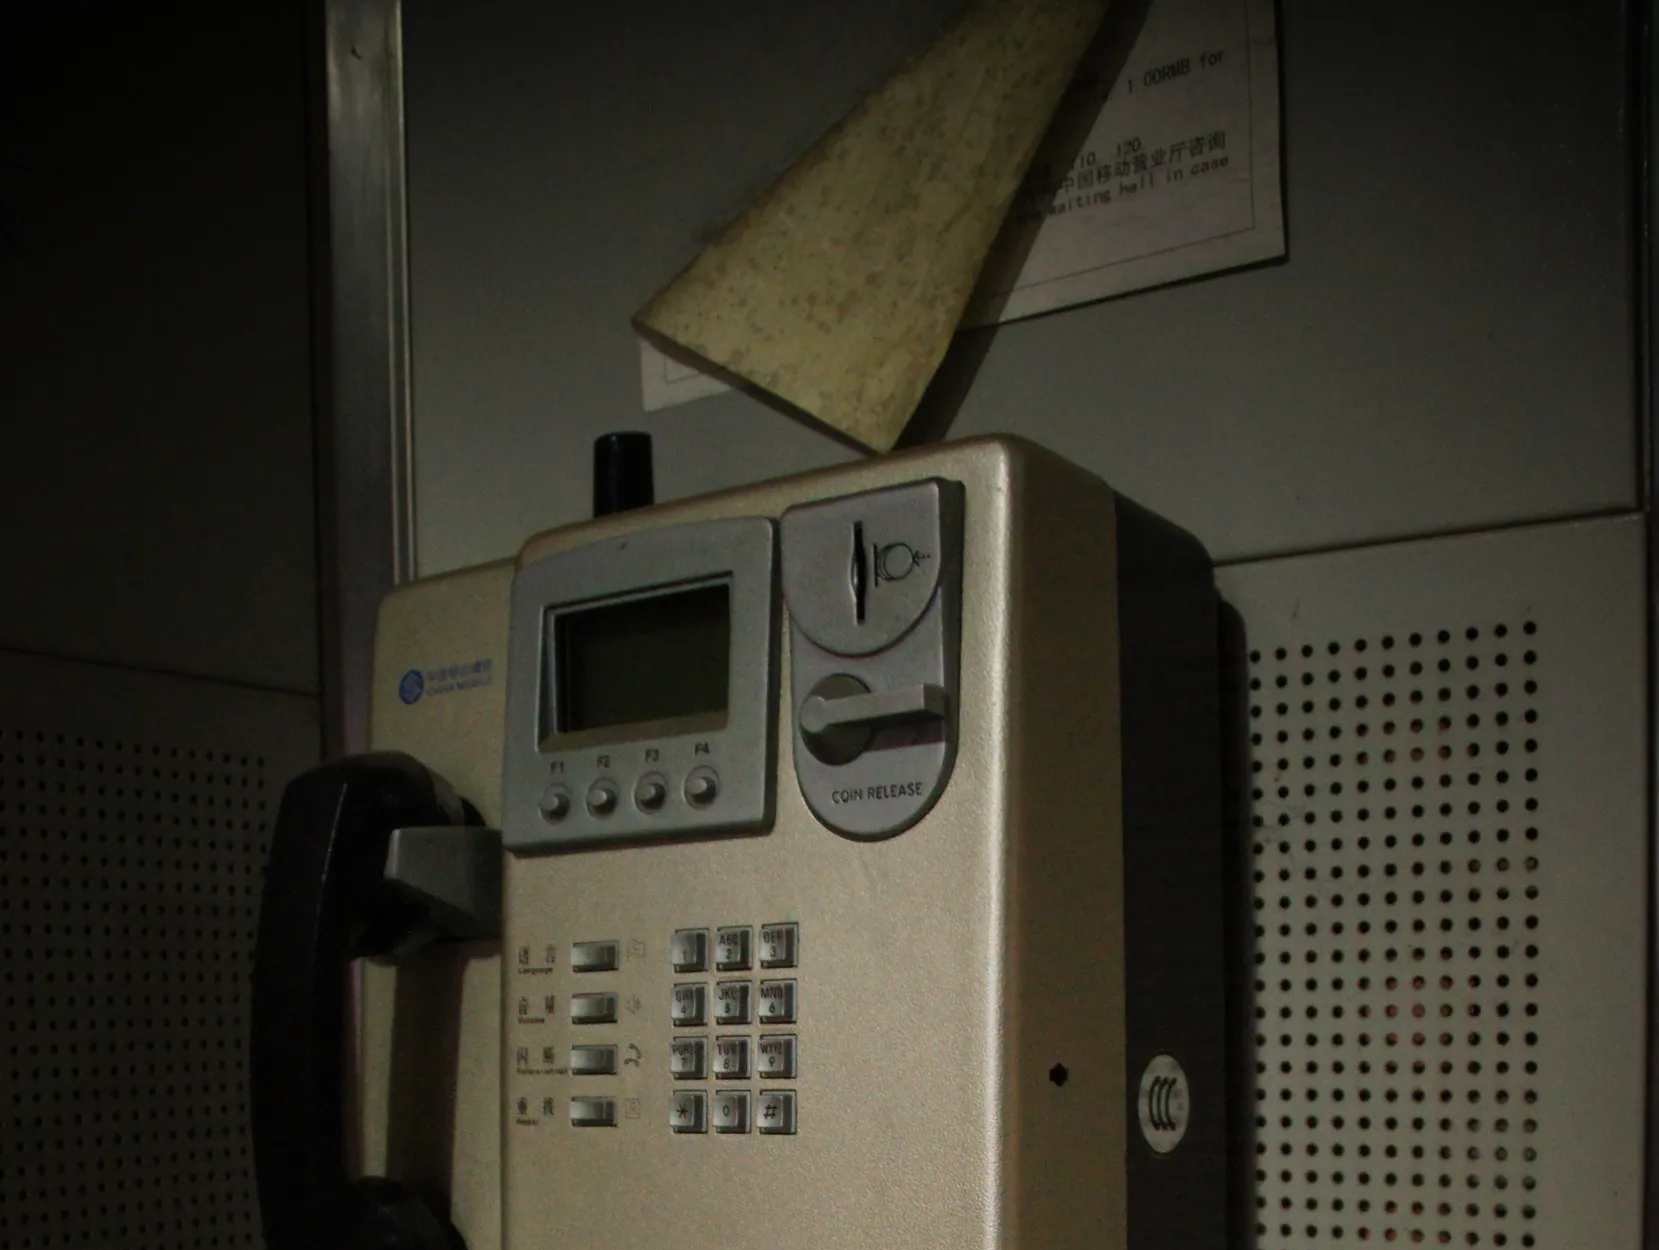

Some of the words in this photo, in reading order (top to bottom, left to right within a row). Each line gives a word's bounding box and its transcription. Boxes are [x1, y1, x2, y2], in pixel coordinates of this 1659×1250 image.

[1199, 50, 1226, 74] for
[1115, 136, 1142, 158] 120
[1166, 166, 1184, 183] in
[1190, 155, 1230, 177] case
[644, 747, 660, 763] F3
[693, 741, 711, 756] F4
[549, 761, 565, 775] F1
[596, 754, 612, 769] F2
[831, 785, 863, 804] COIN
[866, 781, 923, 801] RELEASE
